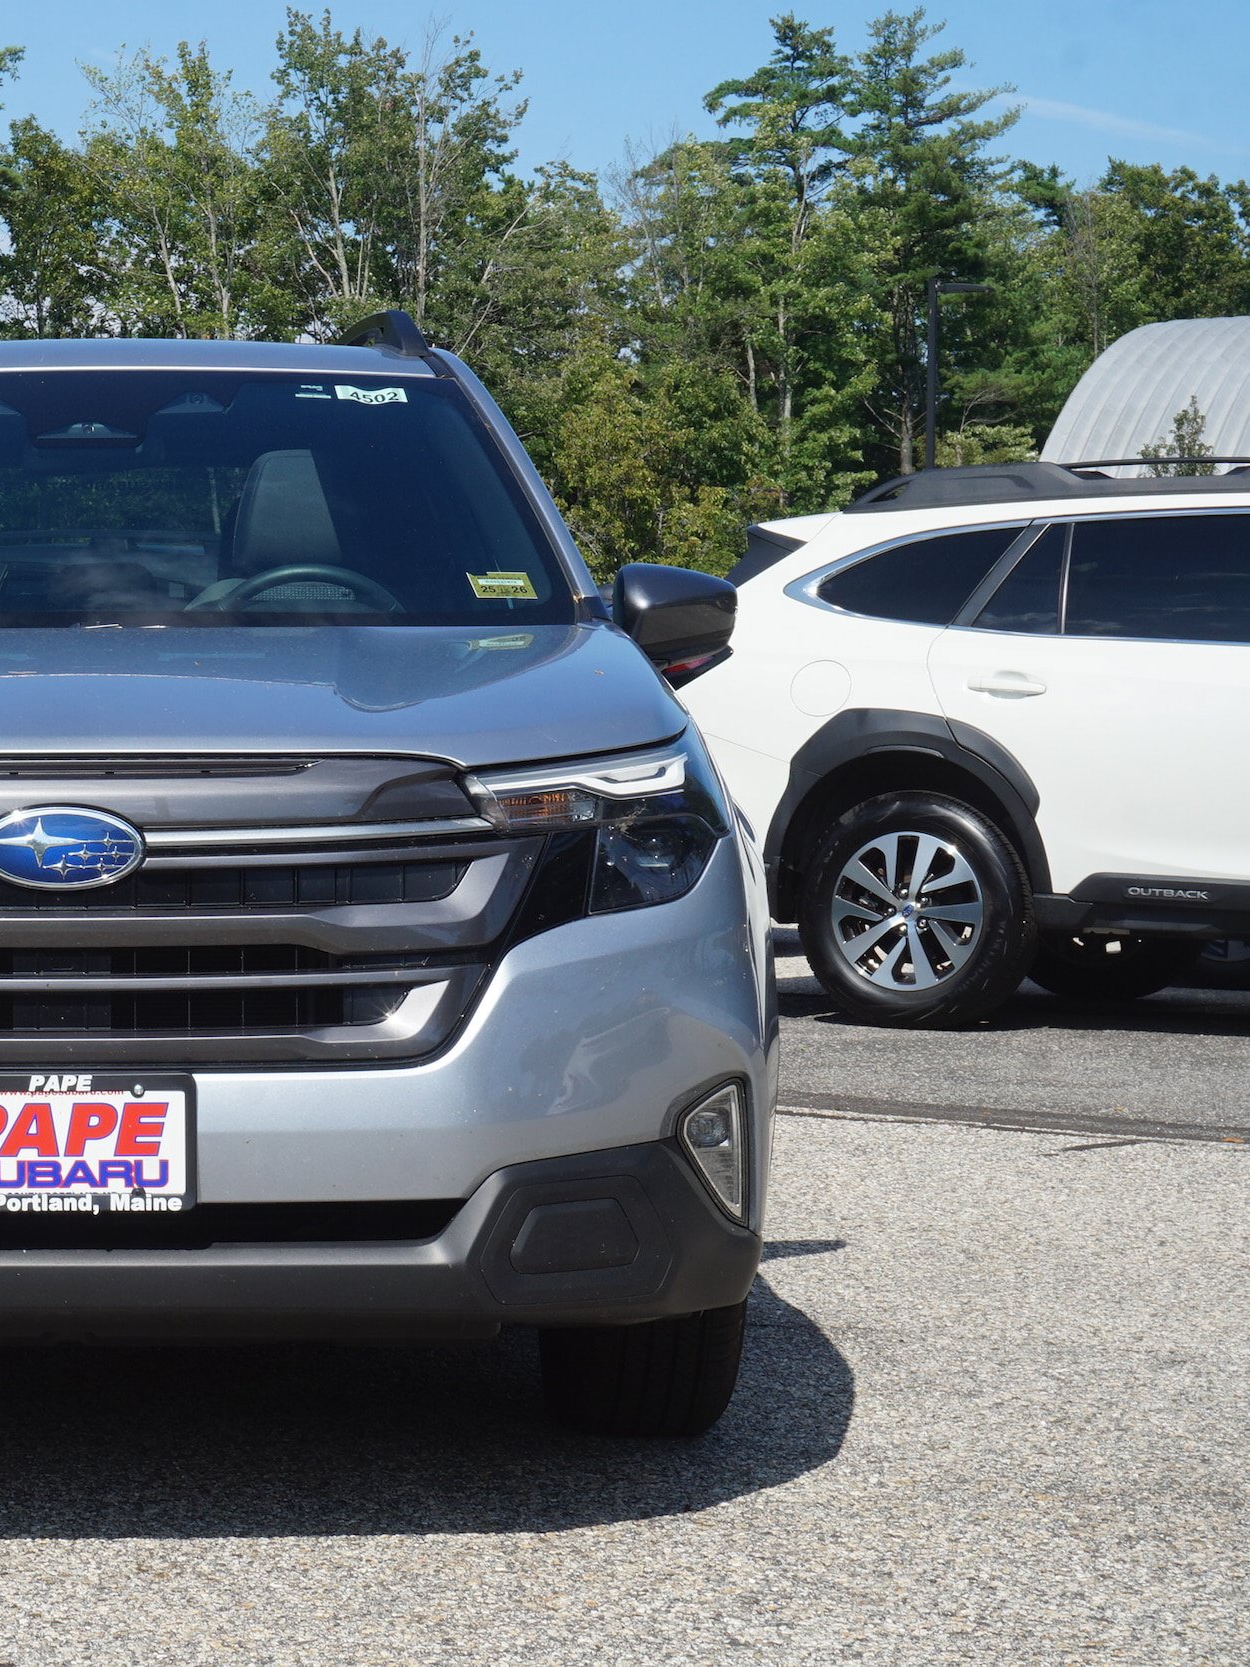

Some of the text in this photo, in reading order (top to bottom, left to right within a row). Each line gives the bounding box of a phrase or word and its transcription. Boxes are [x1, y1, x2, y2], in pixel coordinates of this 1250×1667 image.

[350, 391, 399, 403] 4502
[481, 585, 496, 593] 25
[511, 586, 528, 594] 26
[1128, 886, 1209, 900] OUTBACK
[29, 1075, 93, 1092] PAPE
[110, 1195, 183, 1212] Maine
